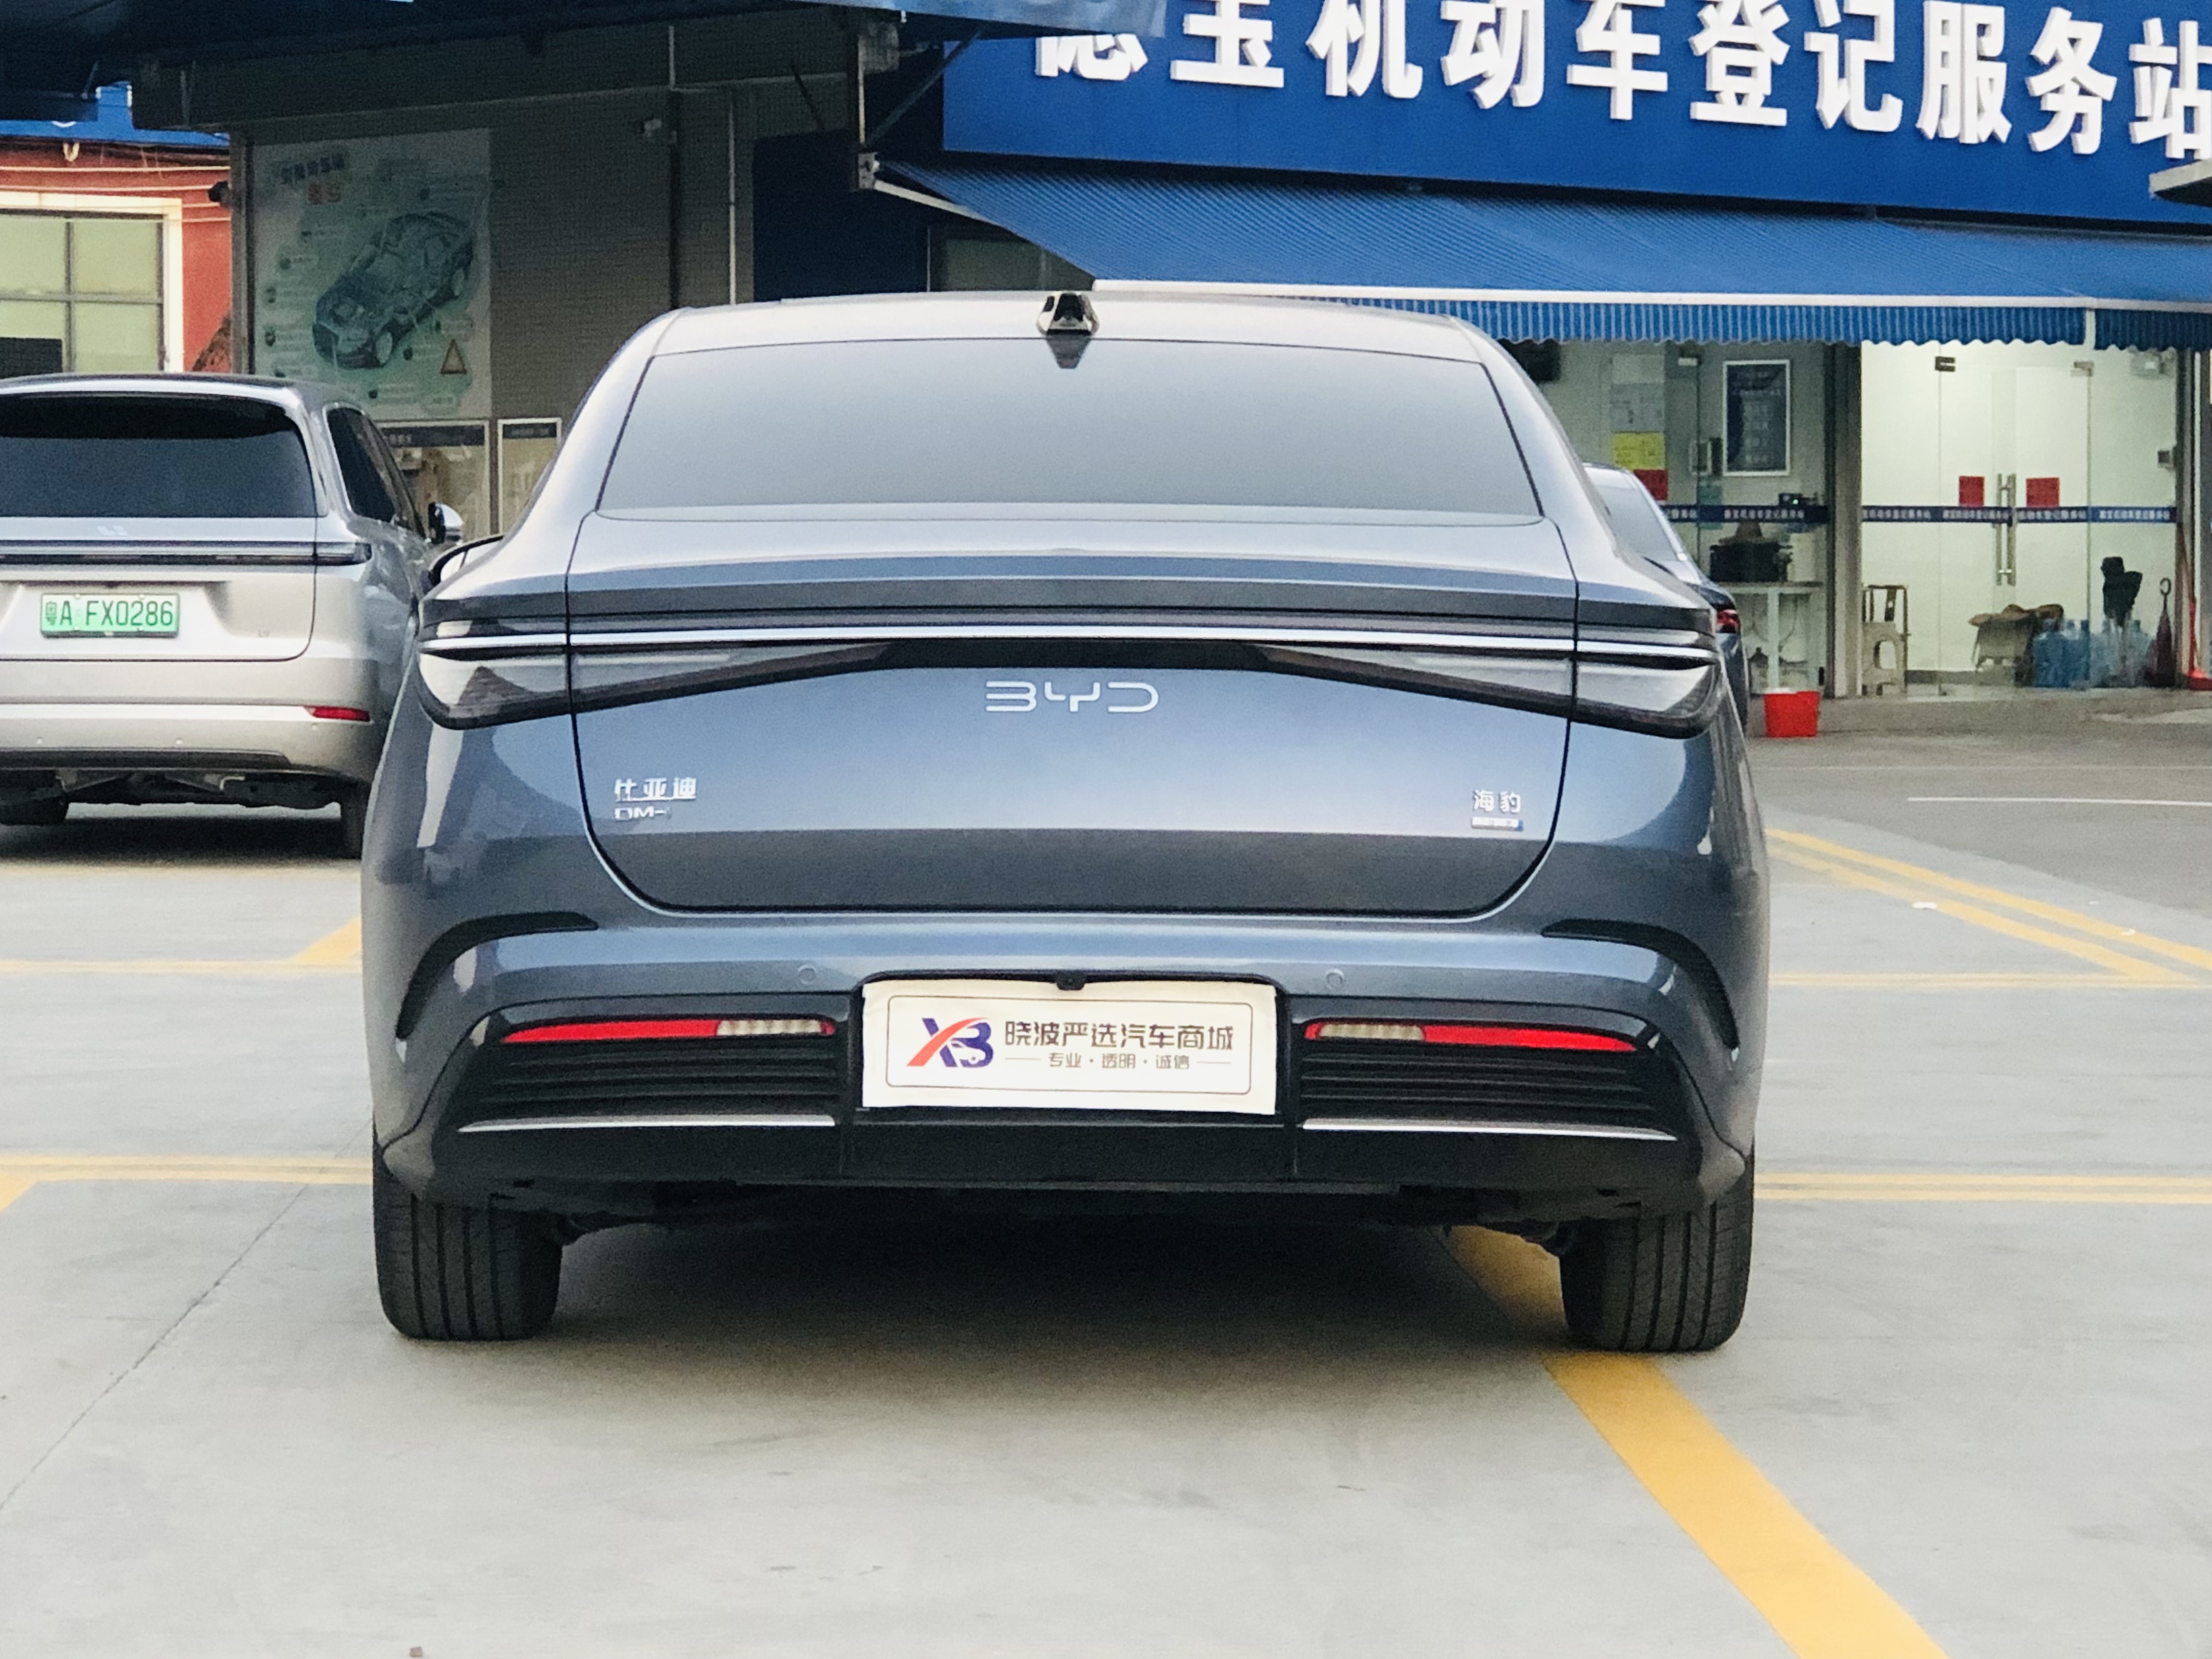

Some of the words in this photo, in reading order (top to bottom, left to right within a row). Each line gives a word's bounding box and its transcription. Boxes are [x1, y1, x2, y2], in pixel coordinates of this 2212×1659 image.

[86, 600, 173, 626] FX0286
[986, 681, 1159, 713] BYD
[1472, 789, 1521, 813] 海豹
[1005, 1020, 1233, 1051] 晓波严选汽车商城
